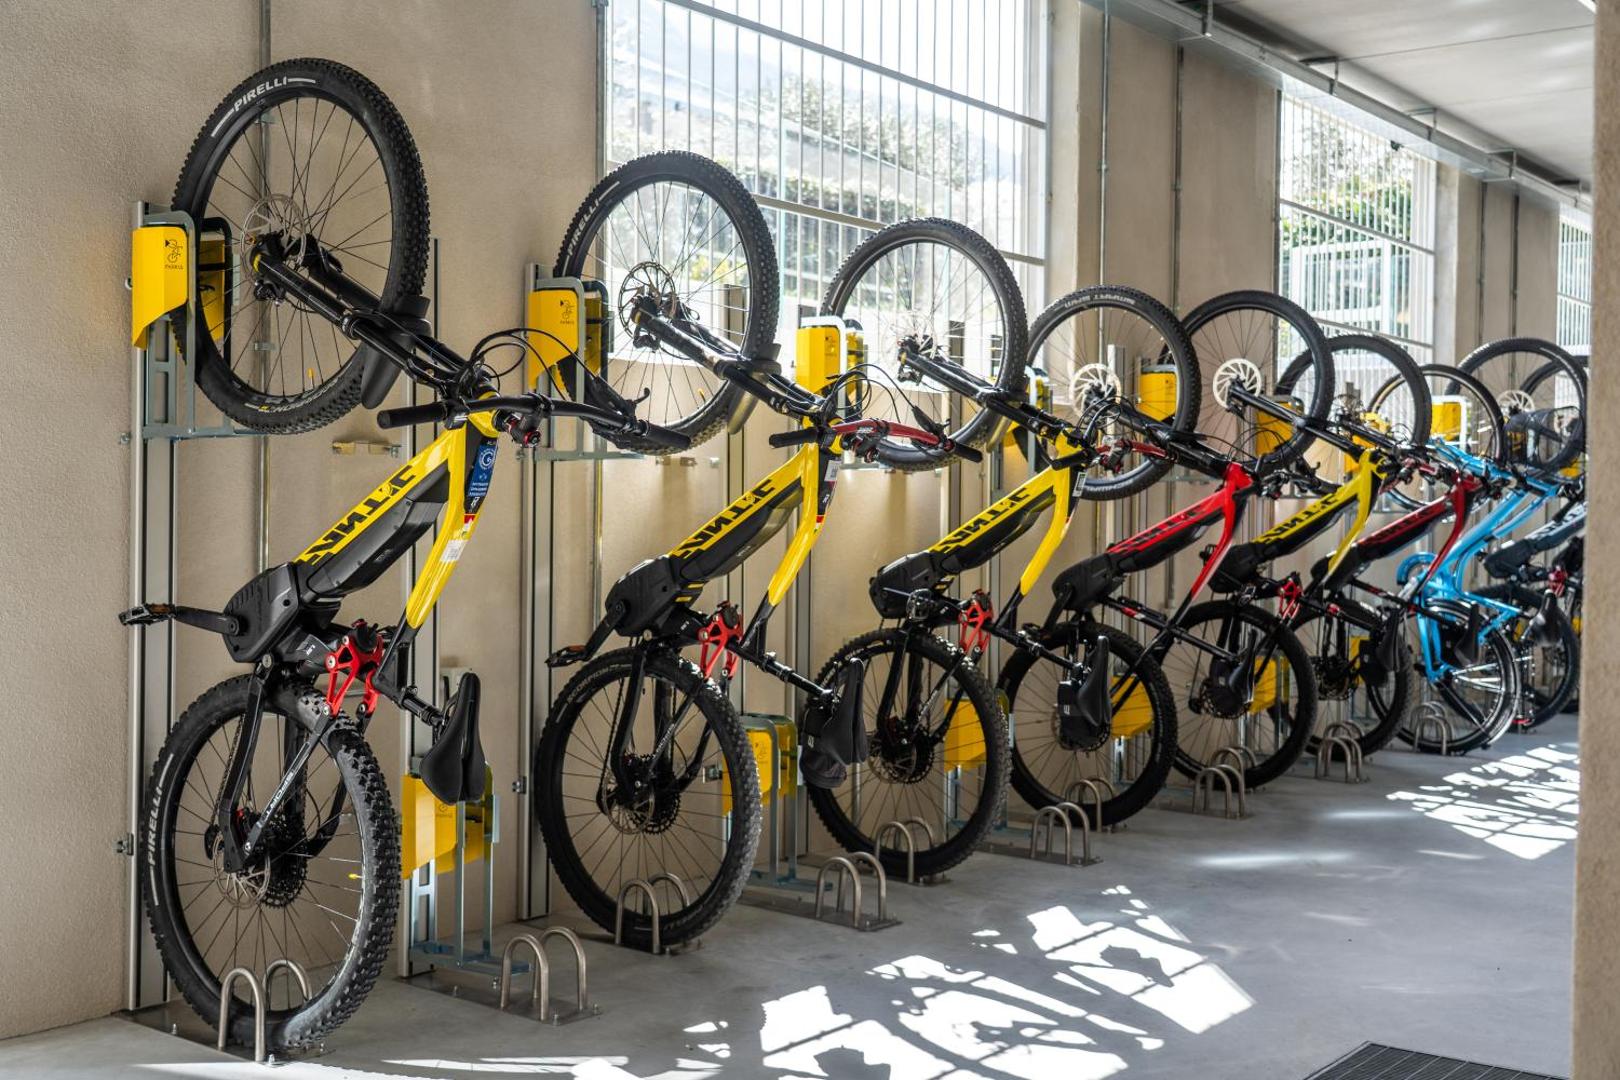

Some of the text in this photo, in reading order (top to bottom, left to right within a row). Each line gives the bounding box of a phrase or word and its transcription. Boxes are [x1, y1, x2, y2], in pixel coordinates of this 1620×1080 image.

[234, 76, 287, 112] PIRELLI
[566, 199, 600, 256] PIRELLI
[148, 787, 163, 866] PIRELLI
